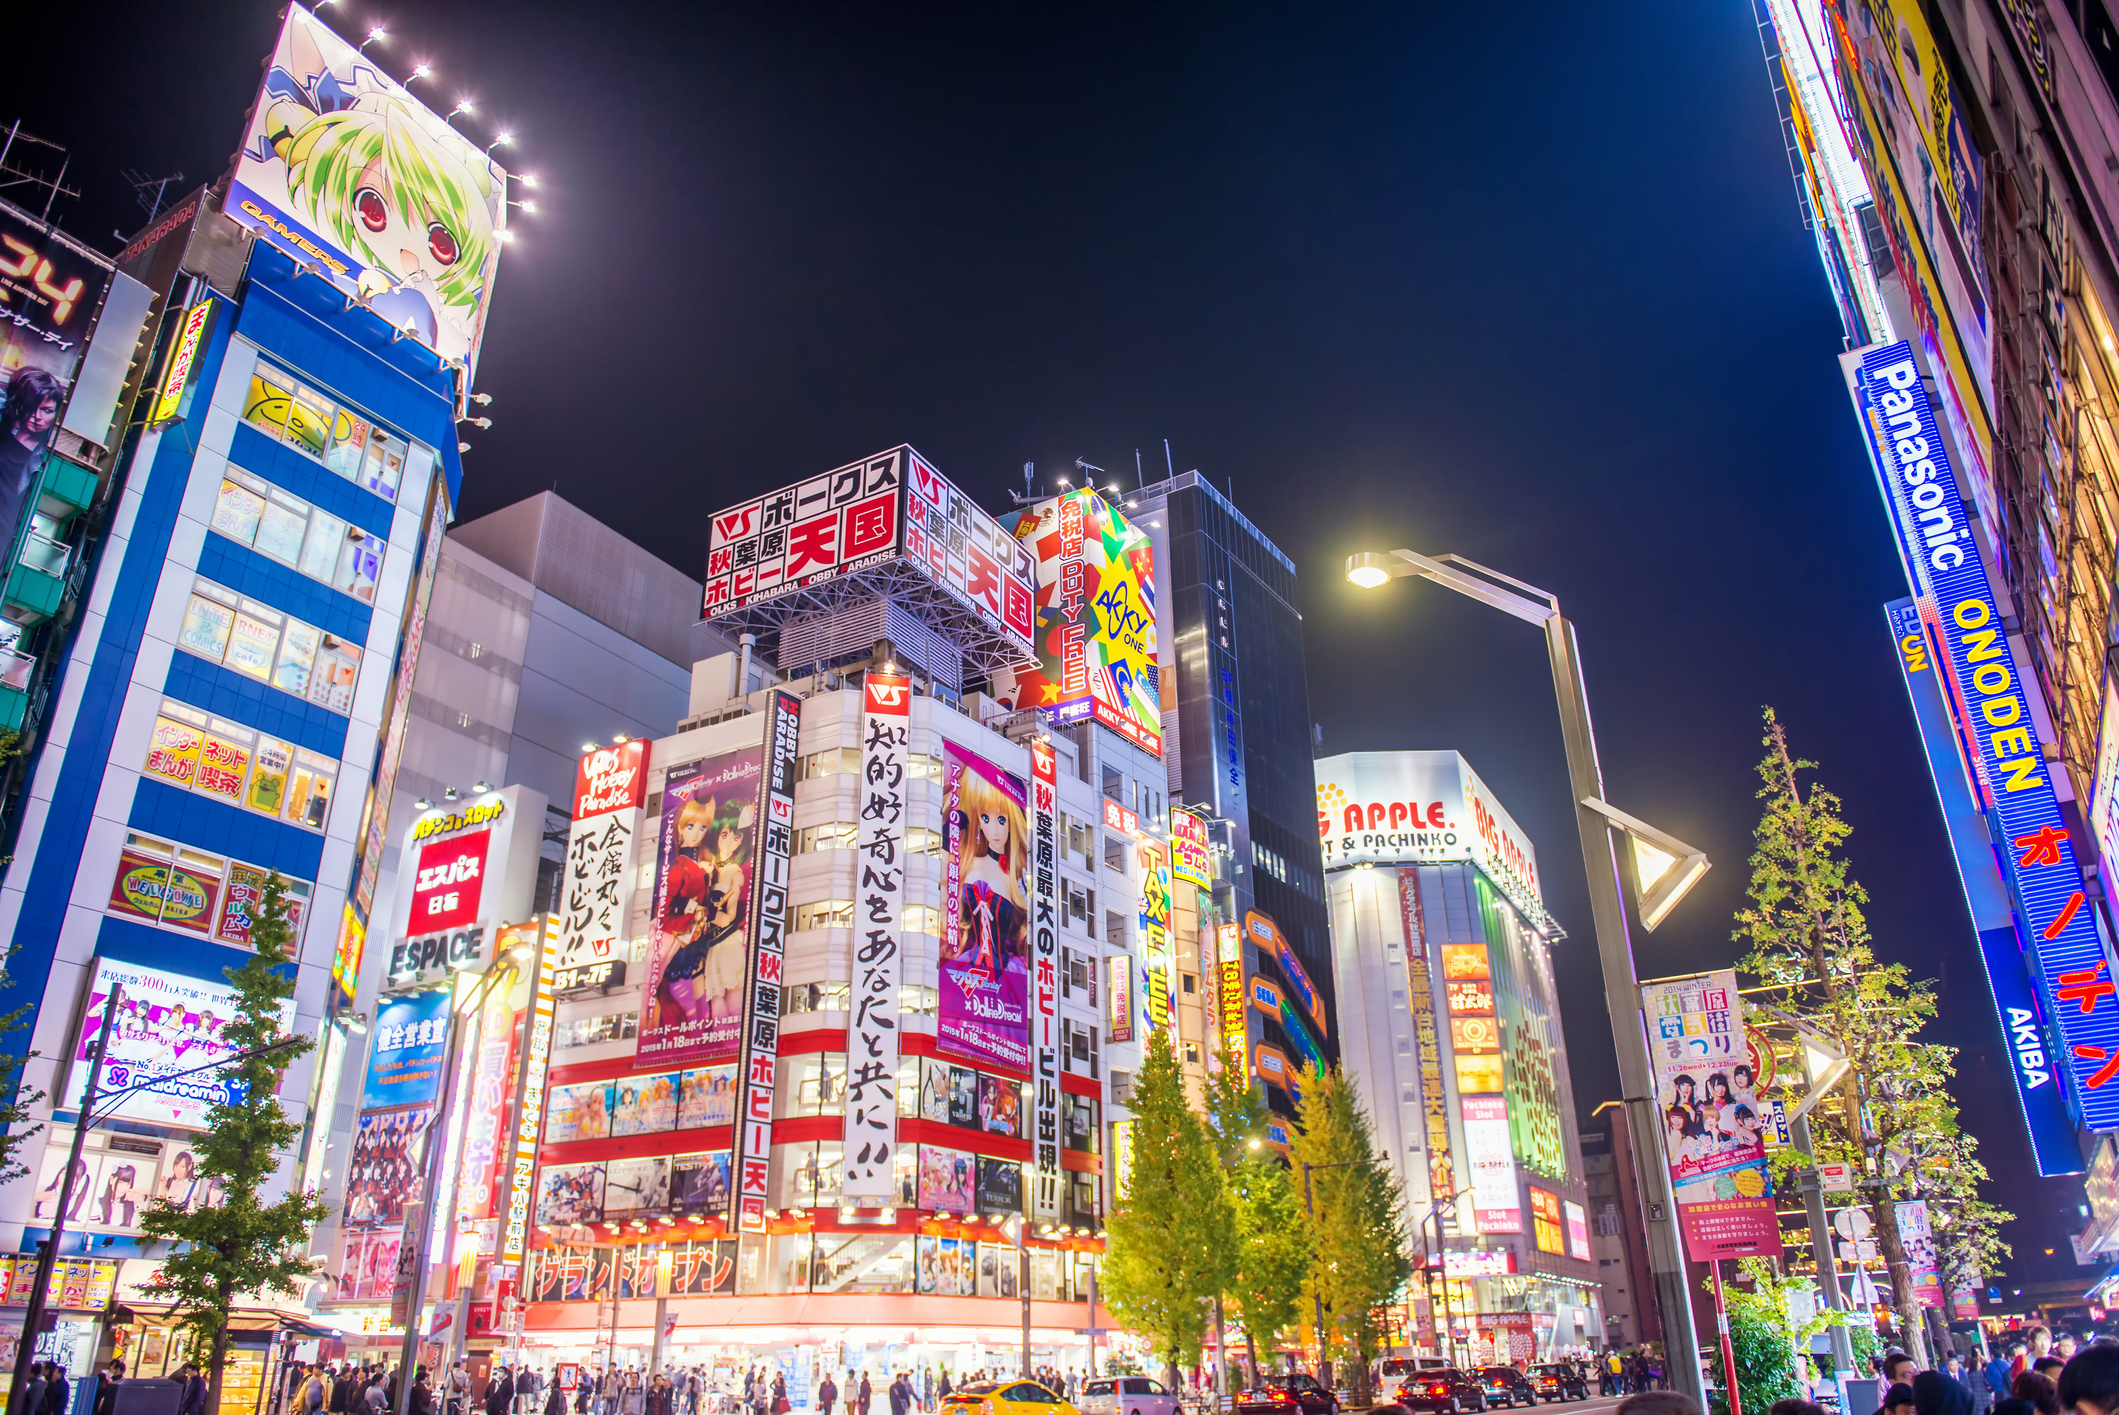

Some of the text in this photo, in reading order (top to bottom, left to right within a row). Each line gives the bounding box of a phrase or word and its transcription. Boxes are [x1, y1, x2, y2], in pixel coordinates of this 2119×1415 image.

[125, 201, 196, 263] TAKARADA
[240, 200, 351, 275] GAMERS
[1873, 360, 1965, 572] Panasonic
[787, 492, 896, 580] 天国
[1060, 500, 1084, 558] 免税店
[708, 530, 786, 575] 秋葉原
[704, 549, 897, 618] VOLKS AKIHABARA HOBBY PARADISE
[906, 551, 933, 578] VOLKS
[933, 572, 977, 613] AKIHABARA
[977, 605, 1002, 630] HOBBY
[966, 544, 1034, 639] 天国
[1060, 563, 1086, 694] DUTY FREE
[1124, 633, 1144, 654] ONE
[235, 651, 259, 665] cafe
[1953, 598, 2044, 793] ONODEN
[785, 697, 799, 765] HOBBY
[1097, 704, 1119, 726] AKKY
[771, 696, 788, 790] PARADISE
[591, 766, 637, 797] HOBBY
[1972, 756, 1989, 786] Store
[578, 788, 632, 818] Paradise
[1107, 803, 1137, 836] 免税
[1342, 832, 1457, 850] & PACHINKO
[1474, 797, 1500, 856] BIG
[416, 855, 480, 892] エスパス
[1145, 847, 1165, 924] TAX
[1175, 865, 1194, 876] MEDIA
[127, 876, 203, 909] WELCOME
[165, 904, 189, 917] AKIBA
[221, 931, 244, 942] AKIBA
[389, 928, 484, 976] ESPACE
[2014, 826, 2119, 1090] オノデン
[1203, 949, 1216, 1028] ラムタラ
[1223, 971, 1239, 981] CD
[1663, 981, 1712, 994] 2014 WINTER
[1256, 985, 1277, 1008] SEGA
[1656, 988, 1728, 1016] 秋葉原
[1660, 1011, 1732, 1038] 電気街
[1666, 1035, 1731, 1059] まつり
[2006, 1007, 2051, 1090] AKIBA
[952, 1109, 972, 1122] vallejo
[1463, 1101, 1504, 1110] Pachinko
[1475, 1110, 1494, 1119] Slot
[1774, 1105, 1789, 1142] スロット
[1478, 1221, 1519, 1231] Pachinko
[1487, 1210, 1506, 1219] Slot
[535, 1246, 733, 1298] グランドオープン
[1482, 1315, 1498, 1325] BIG
